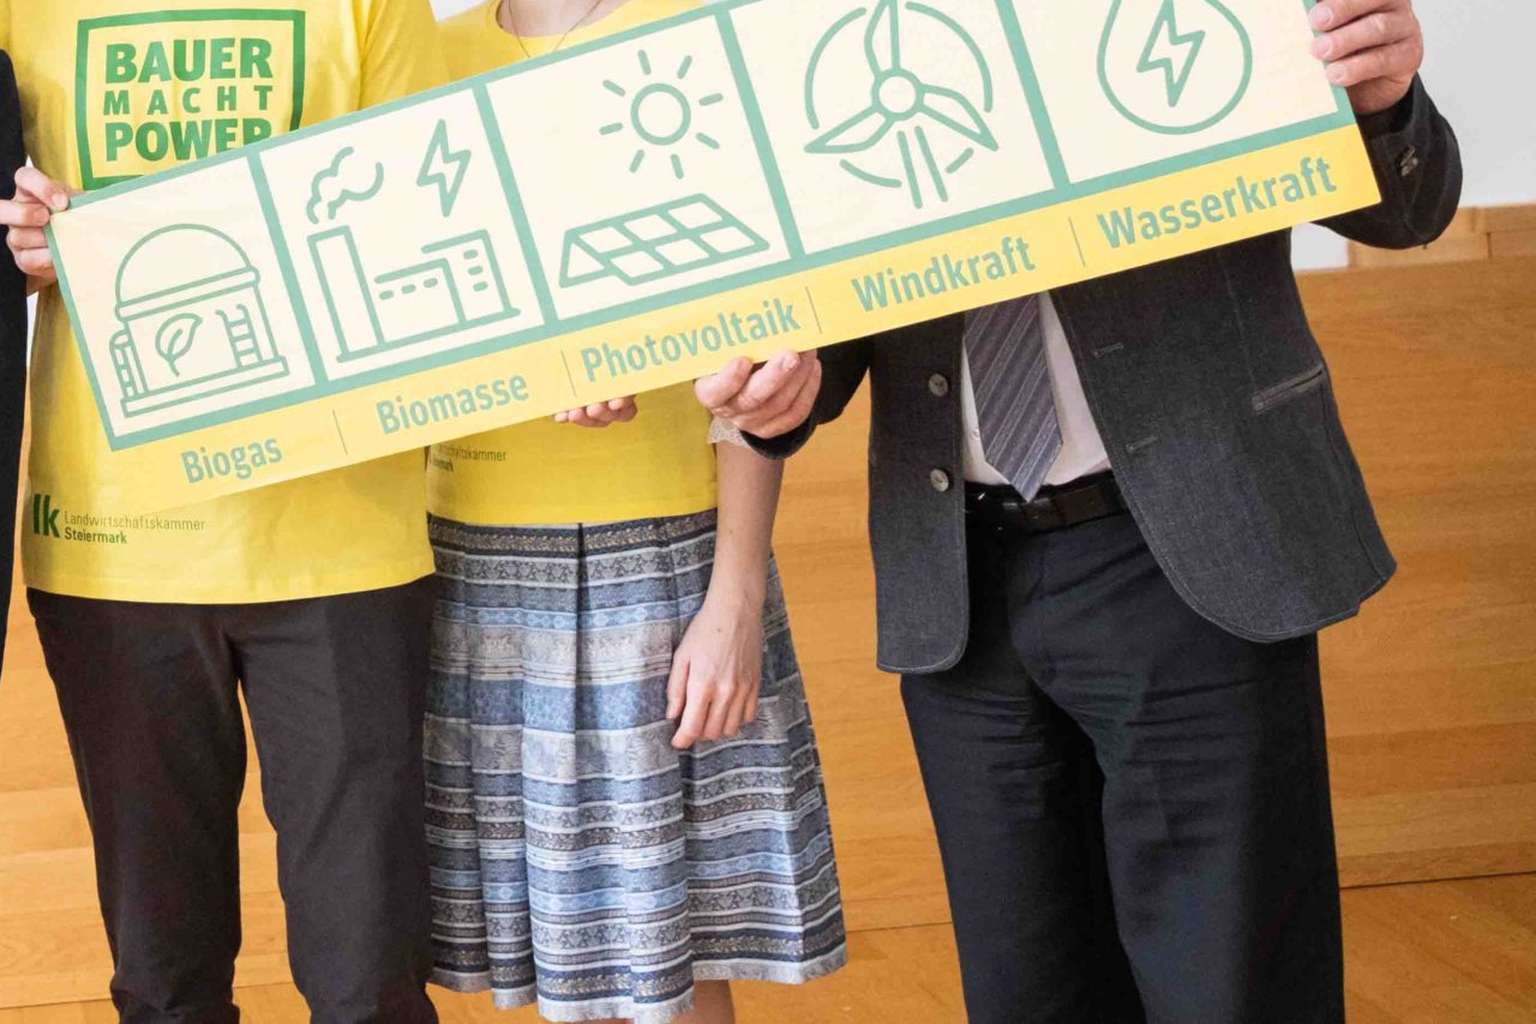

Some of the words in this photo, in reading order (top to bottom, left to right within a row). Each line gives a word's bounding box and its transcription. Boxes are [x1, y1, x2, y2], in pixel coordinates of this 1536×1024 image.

[105, 38, 273, 84] BAUER
[103, 85, 273, 115] MACHT
[181, 435, 283, 485] Biogas
[375, 373, 529, 435] Biomasse
[580, 297, 801, 382] Photovoltaik
[852, 234, 1036, 313] Windkraft
[1097, 155, 1337, 249] Wasserkraft
[32, 493, 60, 538] lk
[65, 511, 205, 531] Landwirtschaftskammer
[65, 527, 127, 544] Steiermark
